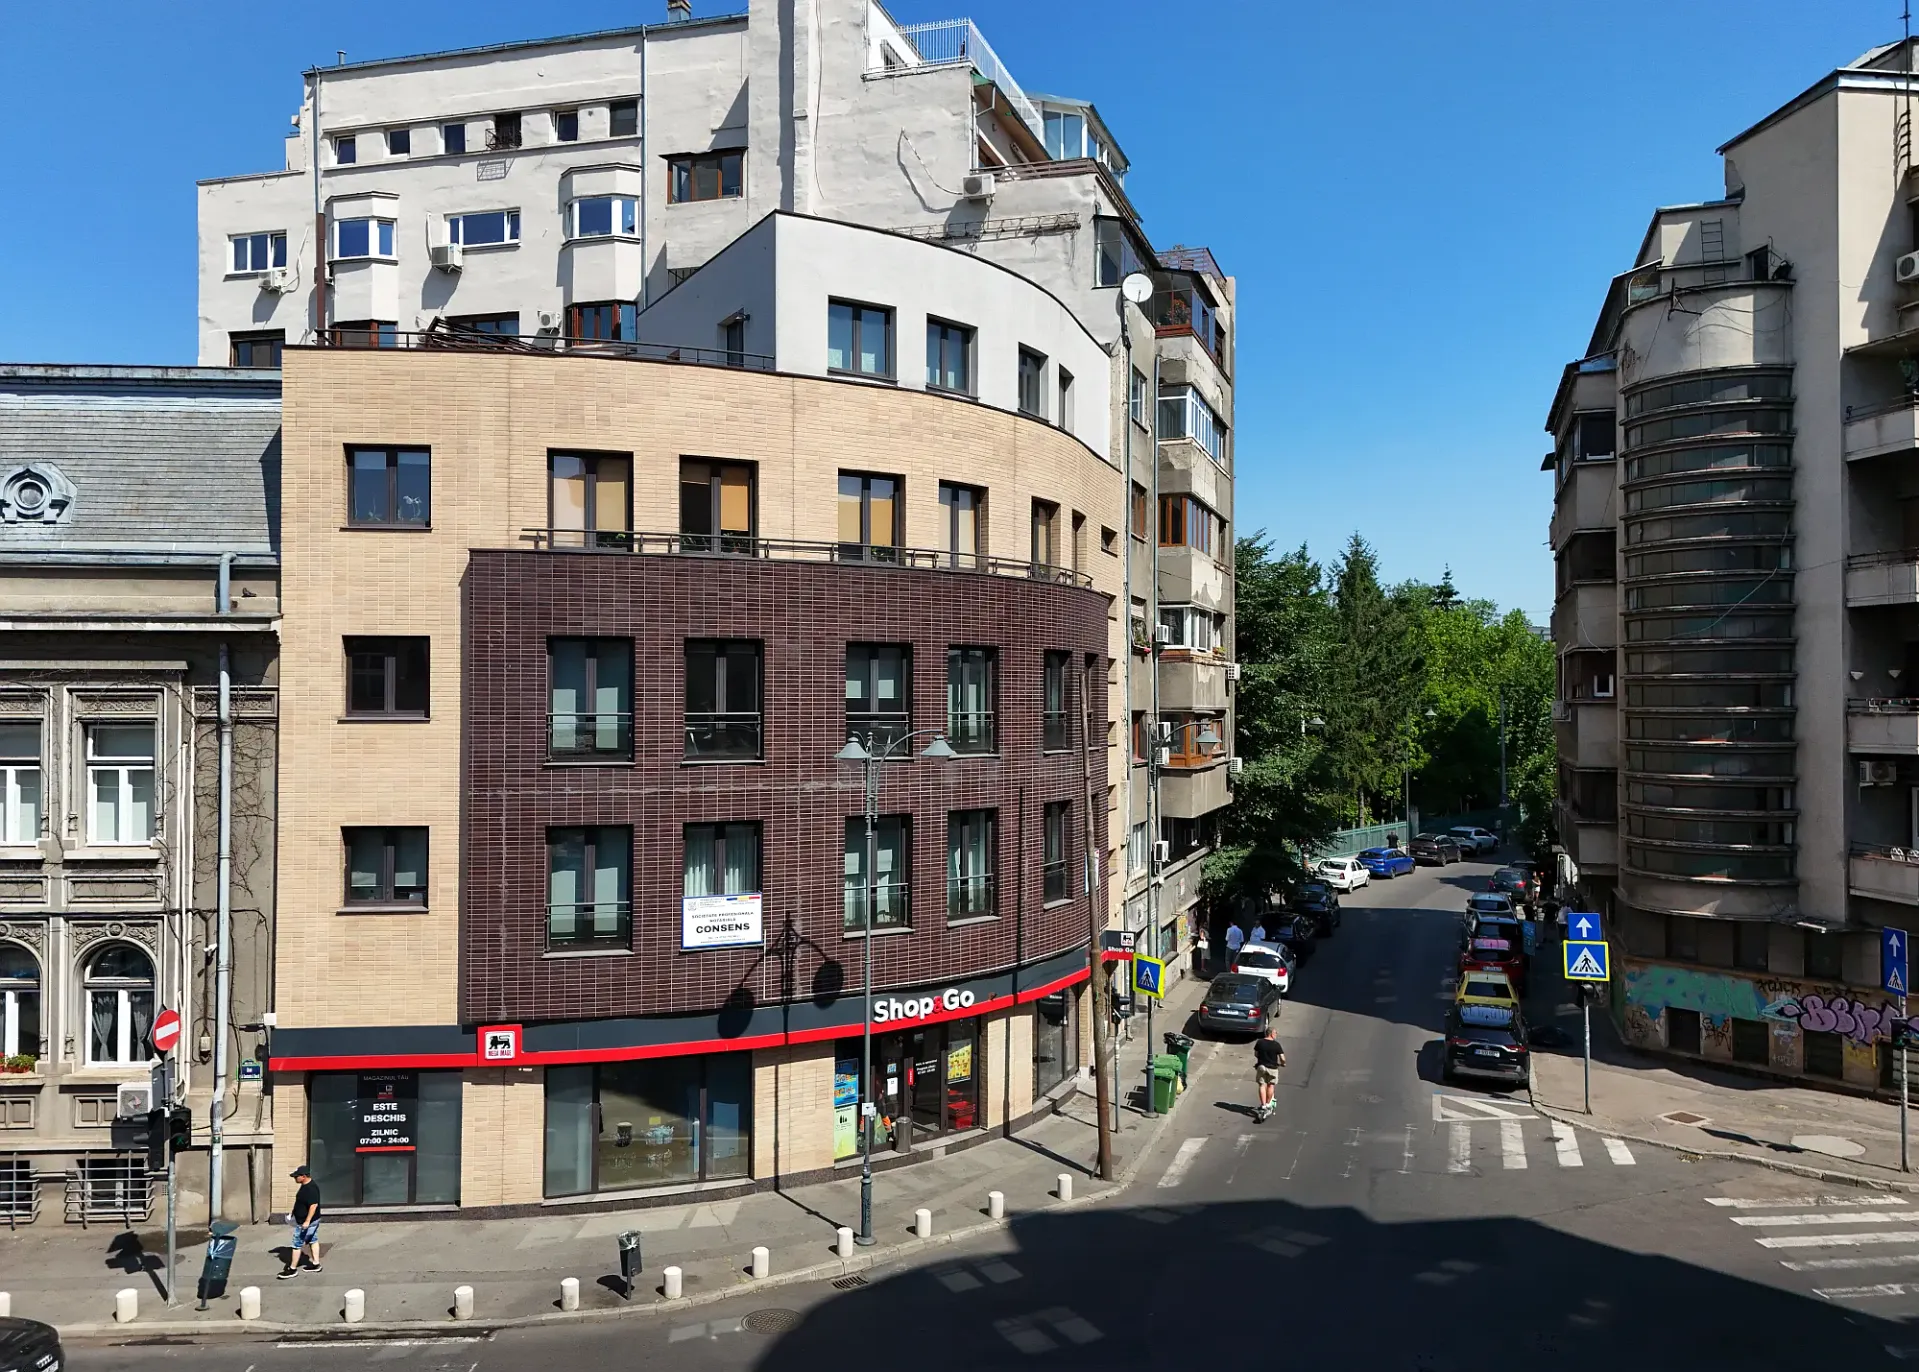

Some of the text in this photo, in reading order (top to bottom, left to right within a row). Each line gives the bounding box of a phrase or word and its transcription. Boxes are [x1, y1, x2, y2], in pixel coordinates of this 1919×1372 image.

[696, 922, 750, 934] CONSENS
[874, 988, 975, 1022] Shop&Go
[373, 1102, 398, 1111] ESTE
[363, 1114, 407, 1122] DESCHIS
[371, 1128, 399, 1136] ZILNIC
[388, 1136, 409, 1144] 24:00
